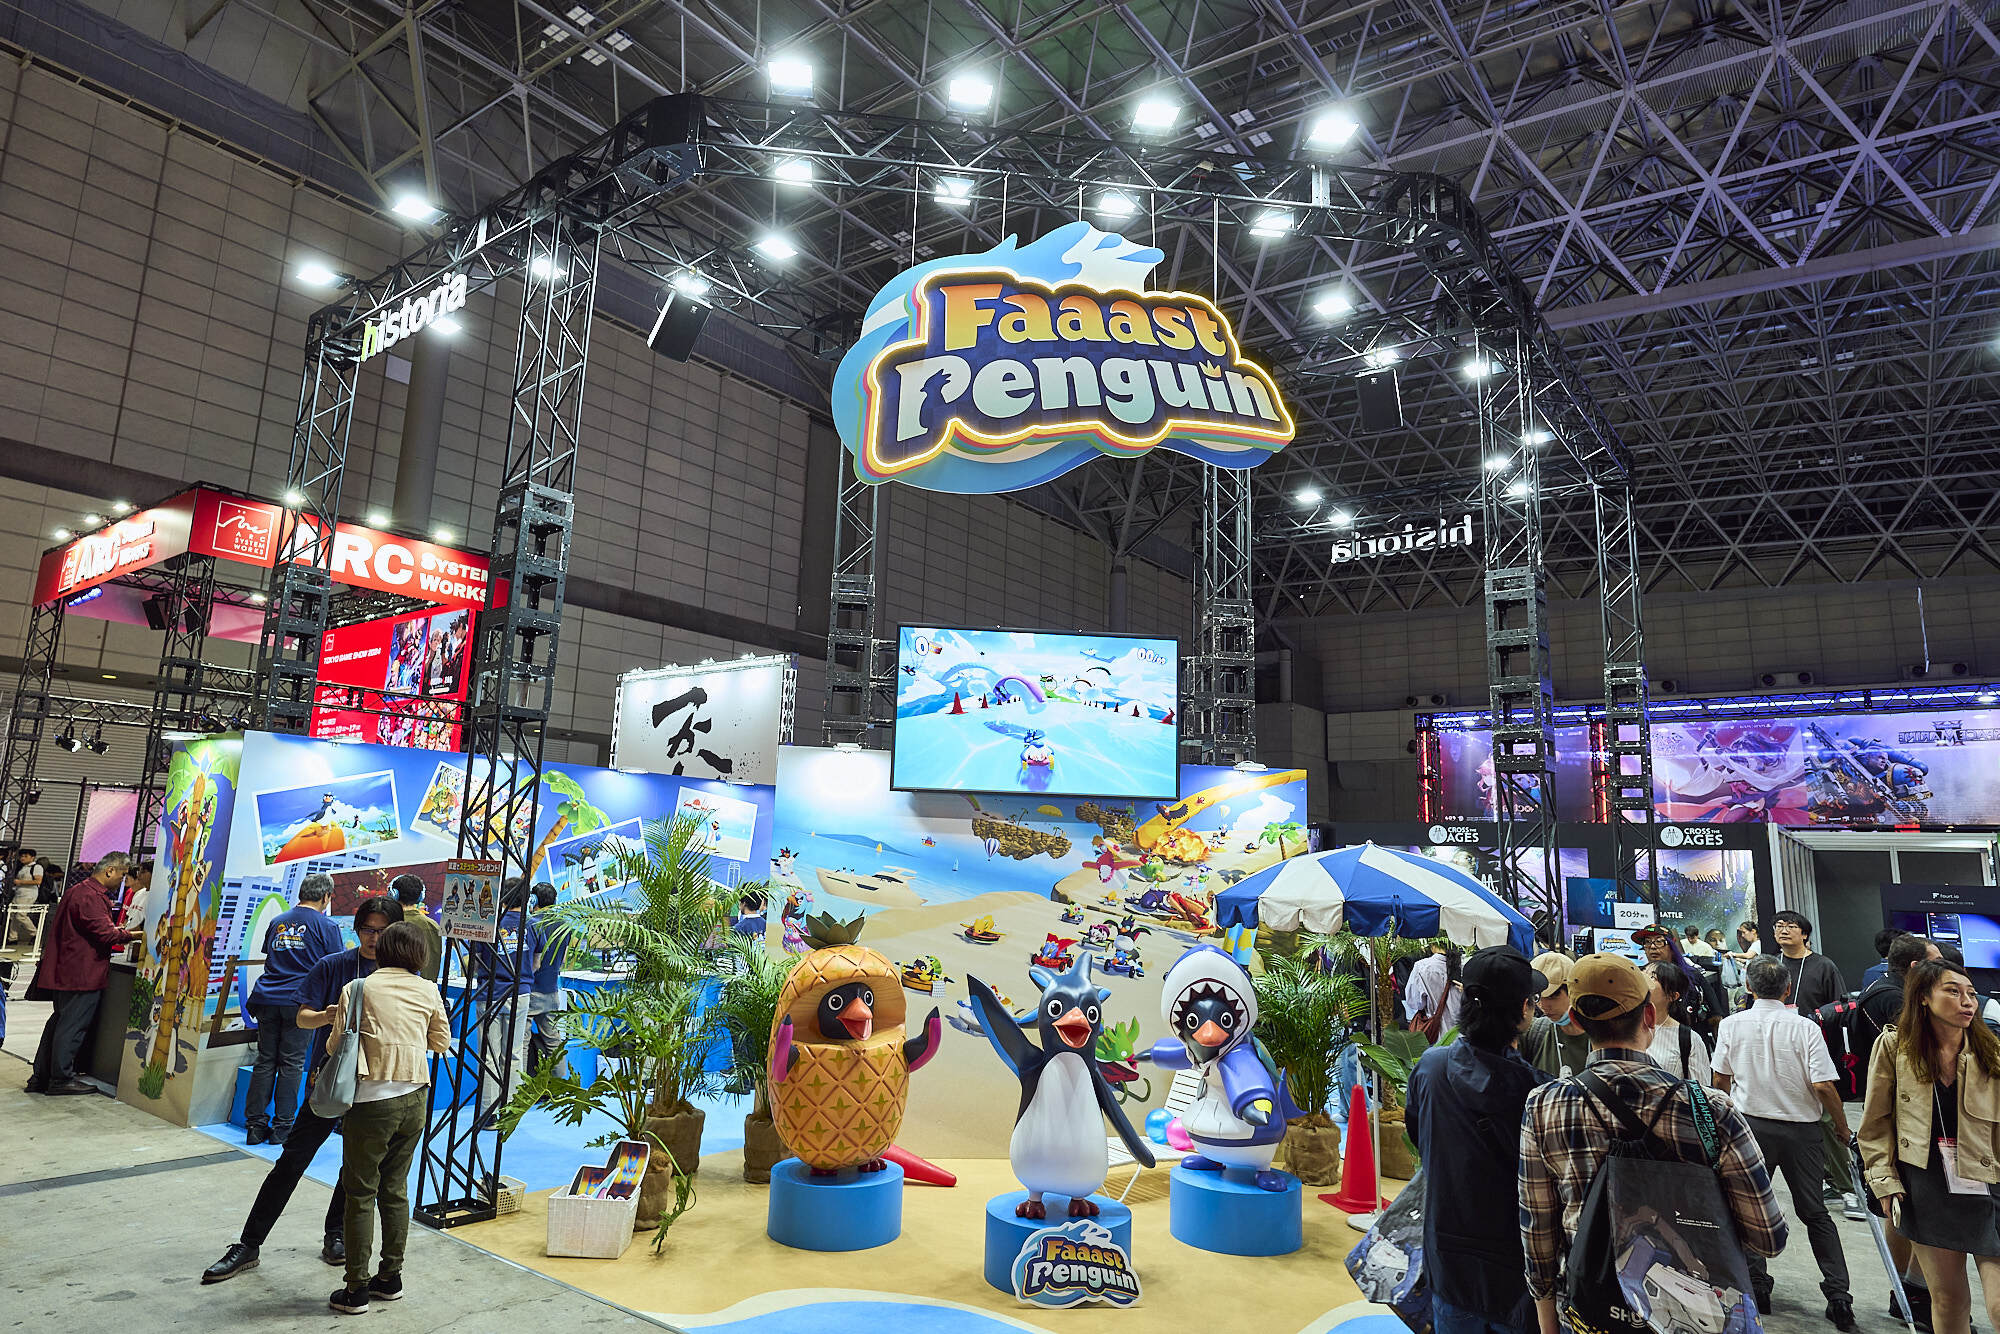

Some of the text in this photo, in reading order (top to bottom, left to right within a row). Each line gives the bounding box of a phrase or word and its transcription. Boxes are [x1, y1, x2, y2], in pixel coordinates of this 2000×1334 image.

[361, 272, 468, 362] historia
[941, 284, 1228, 356] Faaast
[896, 355, 1281, 441] Penguin
[233, 543, 264, 556] WORKS
[235, 537, 265, 549] SYSTEM
[236, 531, 266, 543] ARC
[280, 522, 415, 585] ARC
[915, 635, 929, 656] 0
[1447, 833, 1479, 842] AGES
[1683, 835, 1723, 846] AGES
[1046, 1240, 1124, 1270] Faaast
[1031, 1261, 1136, 1292] Penguin
